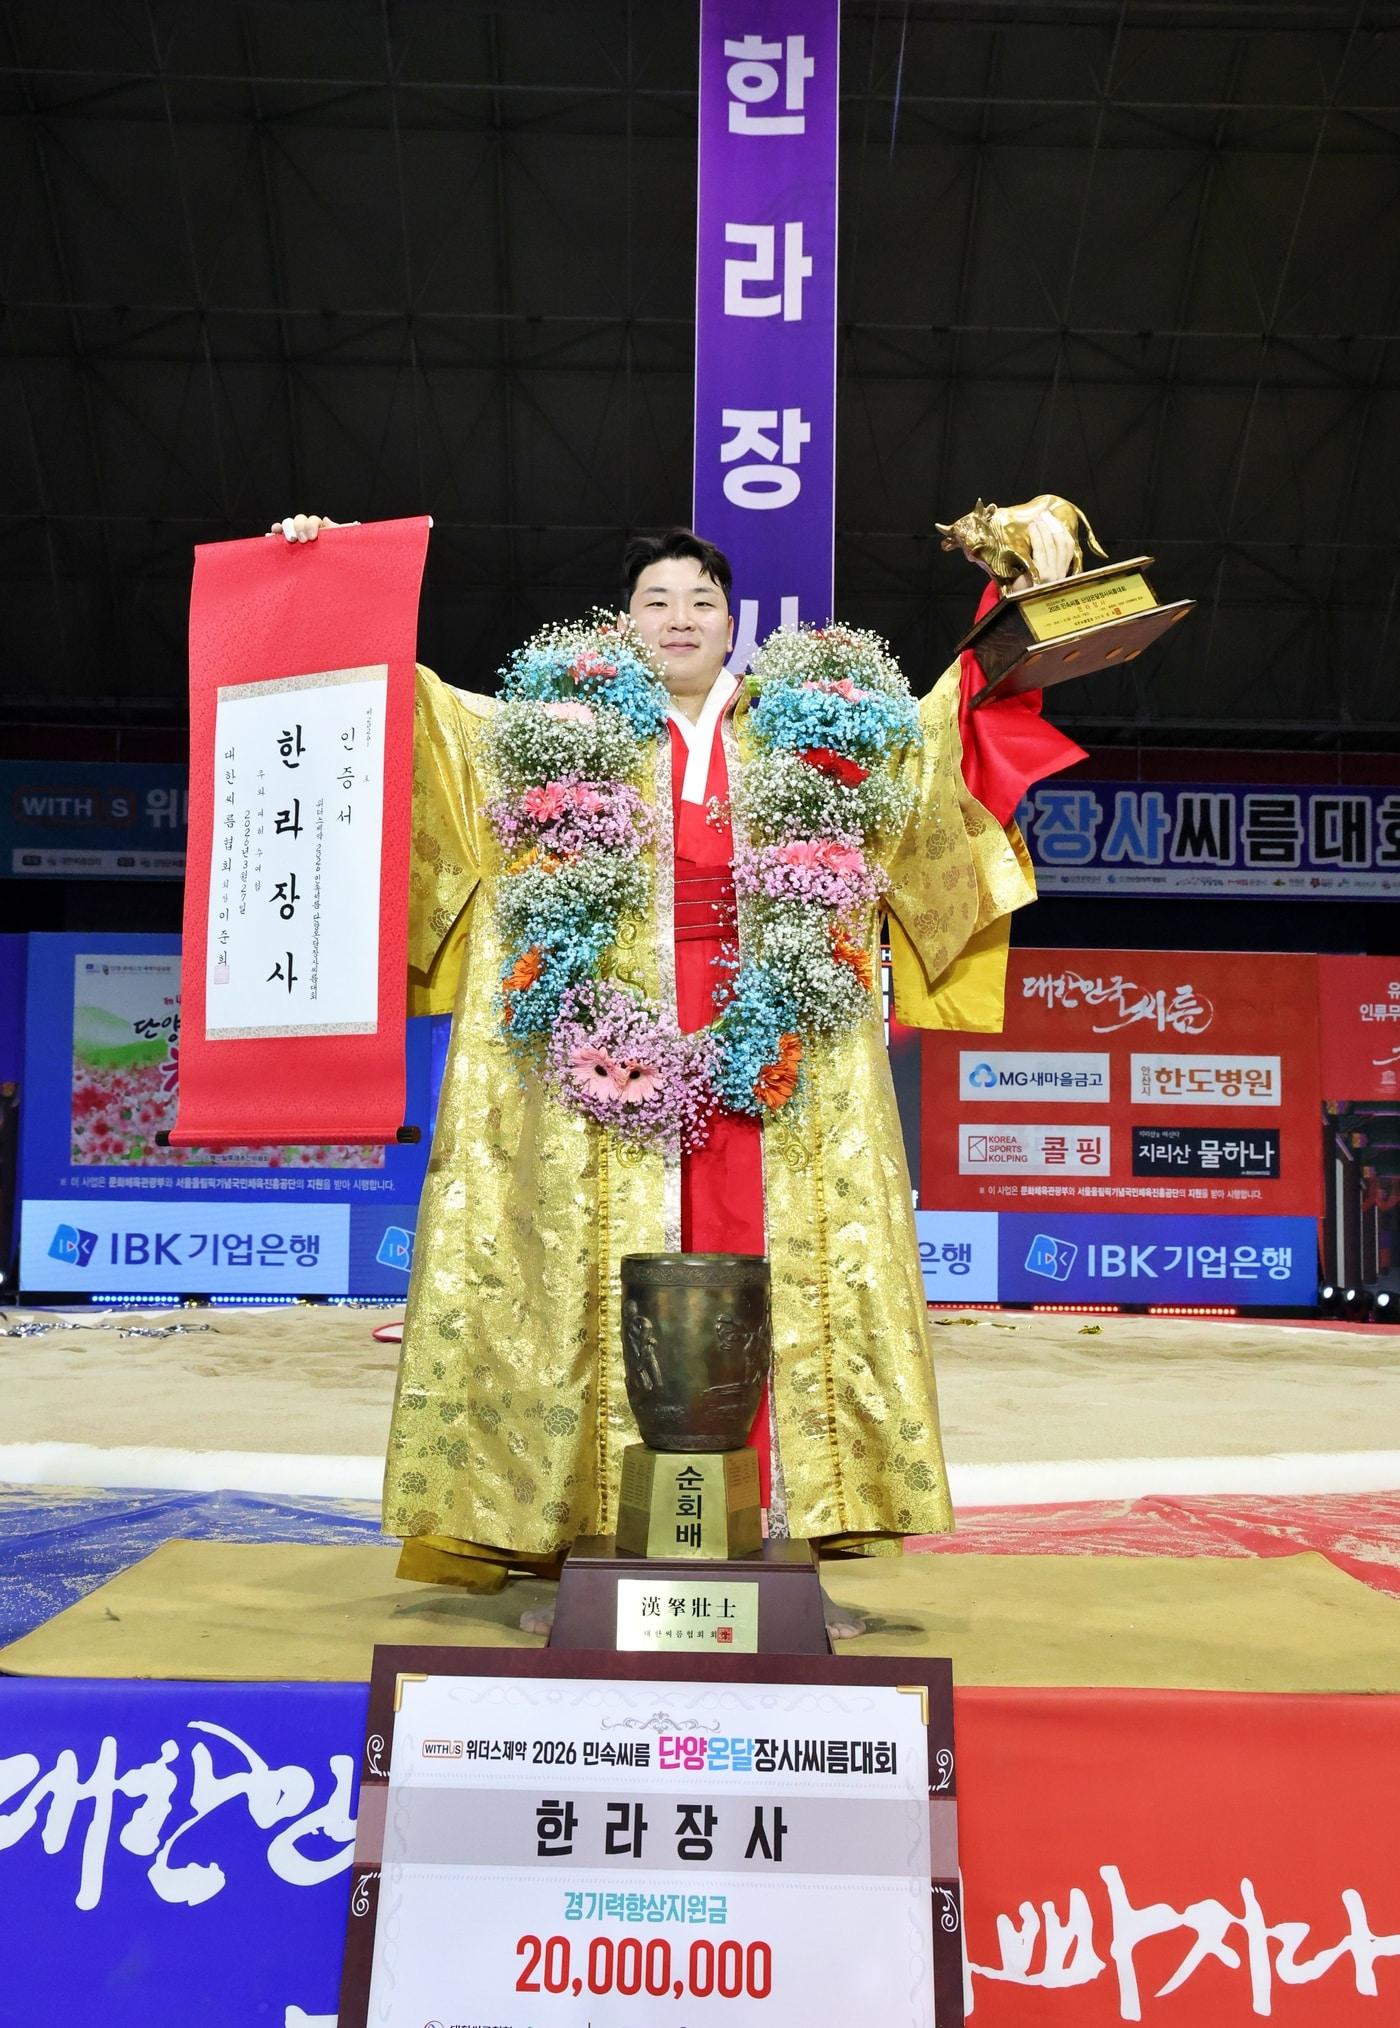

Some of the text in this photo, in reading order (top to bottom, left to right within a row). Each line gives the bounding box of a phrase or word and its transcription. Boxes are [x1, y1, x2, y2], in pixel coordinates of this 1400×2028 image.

[336, 726, 355, 825] 인증서
[144, 787, 189, 829] 위
[1014, 788, 1400, 868] 장사씨름대
[266, 724, 306, 994] 한라장사
[1022, 970, 1138, 1016] 대한민국
[1092, 984, 1214, 1034] 씨름
[1153, 1066, 1273, 1098] 한도병원
[988, 1135, 1017, 1144] KOREA
[988, 1145, 1023, 1153] SPORTS
[988, 1154, 1029, 1163] KOLPING
[1138, 1140, 1275, 1168] 지리산 물하나
[675, 1465, 705, 1548] 순회배
[466, 1740, 527, 1761] 위더스제약
[532, 1741, 577, 1765] 2026
[582, 1741, 651, 1768] 민속씨름
[658, 1736, 897, 1775] 단양온달장사씨름대회
[536, 1799, 788, 1863] 한라장사
[563, 1891, 728, 1925] 경기력향상지원금
[515, 1934, 773, 2001] 20,000,000
